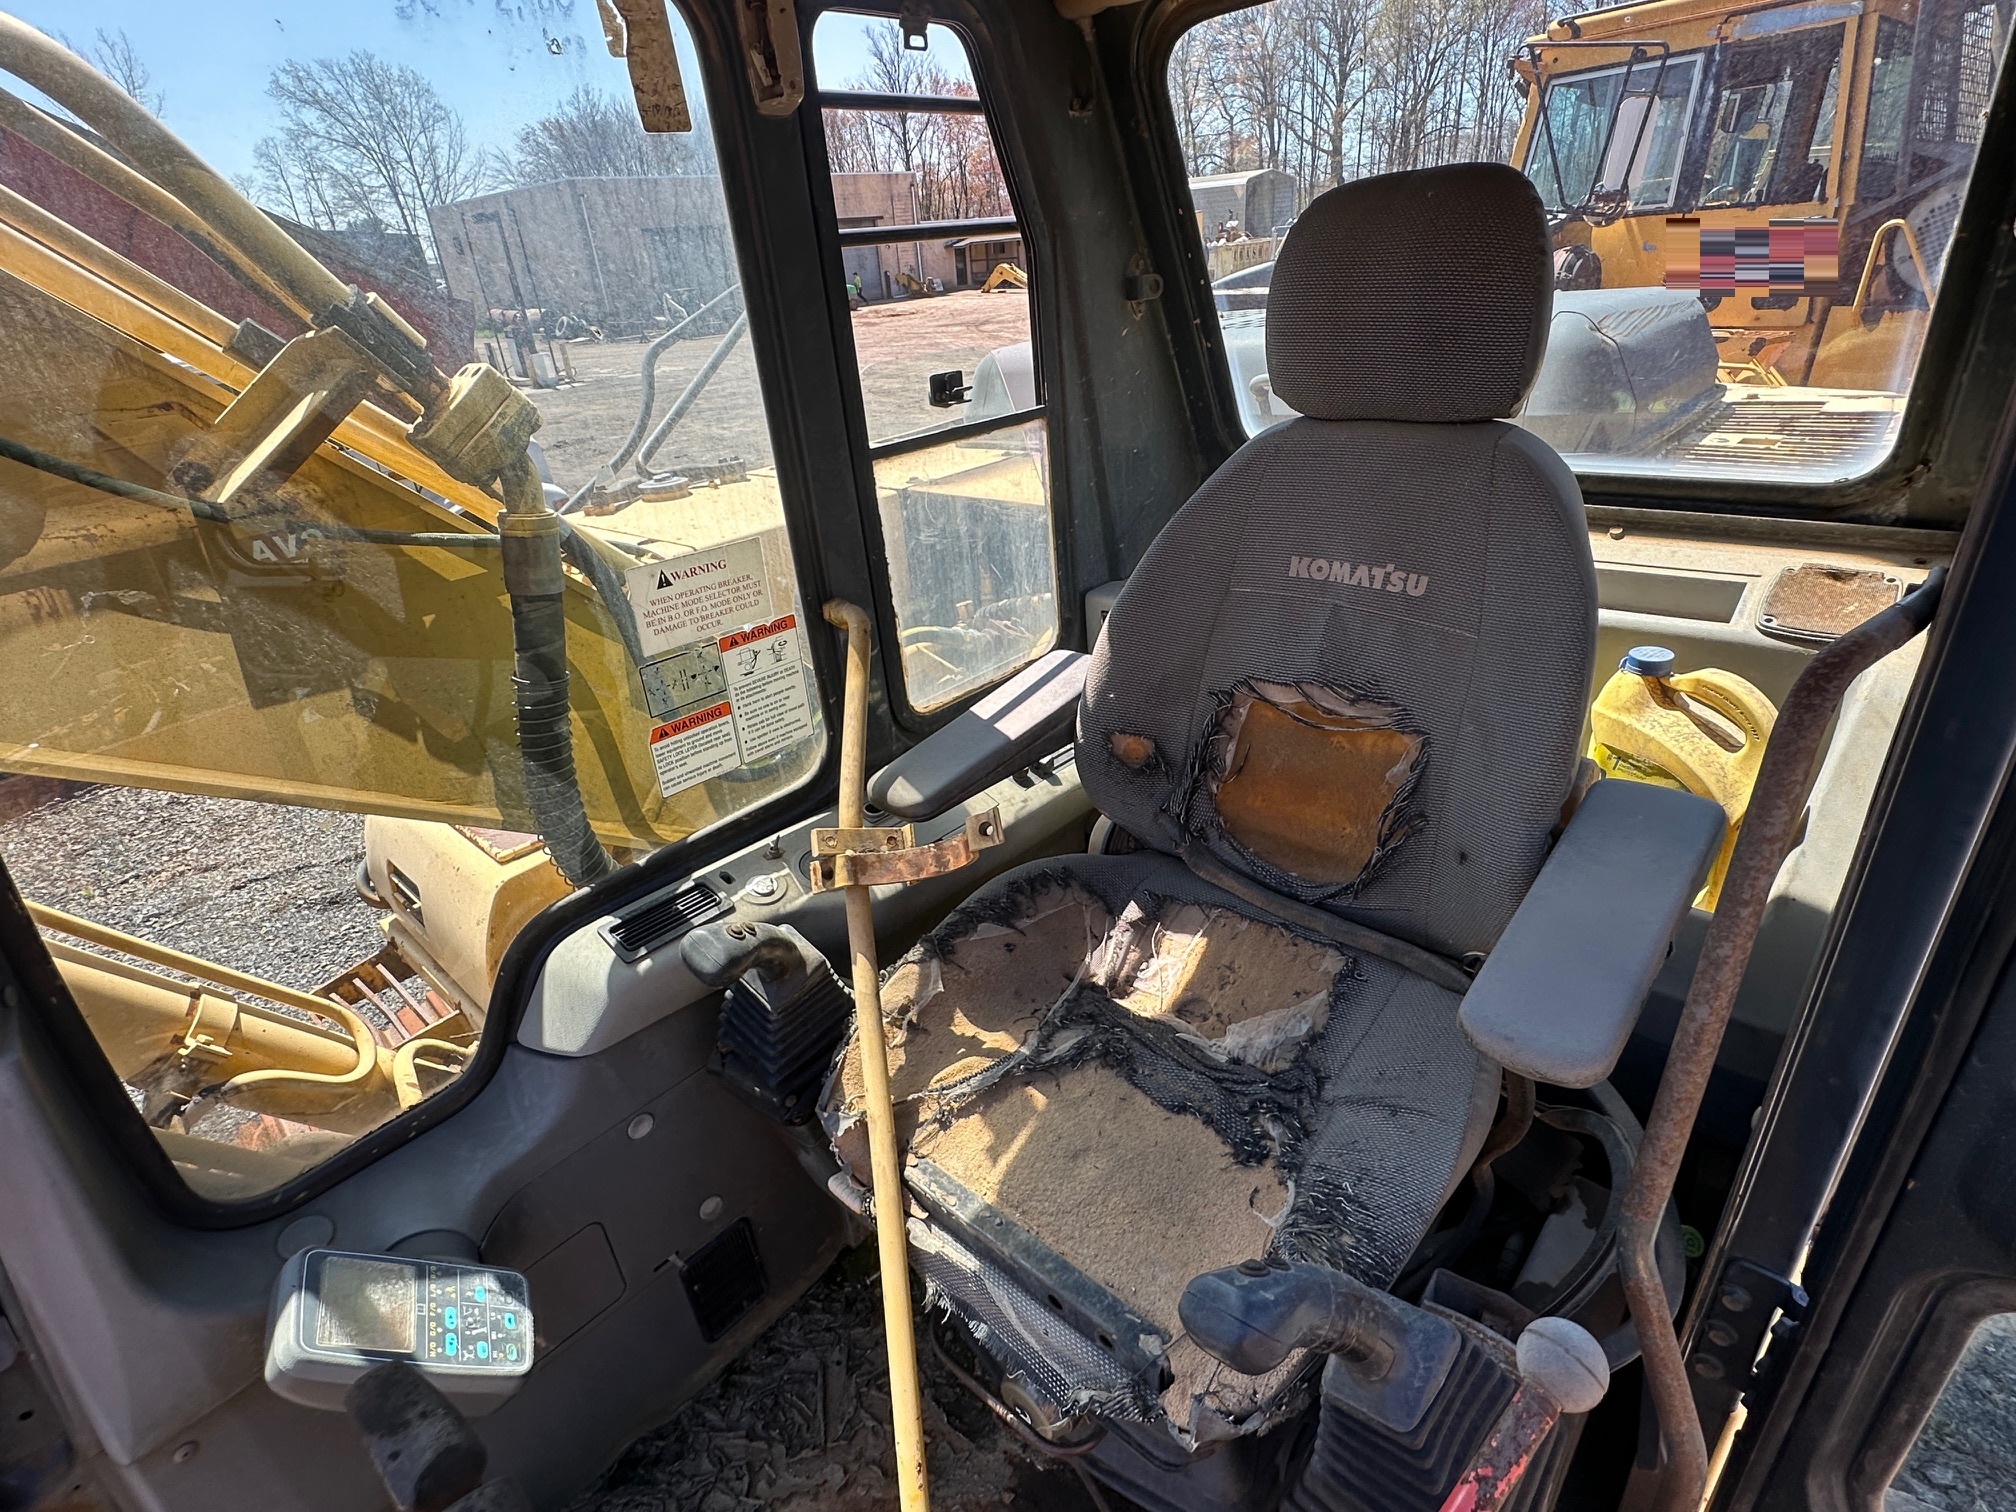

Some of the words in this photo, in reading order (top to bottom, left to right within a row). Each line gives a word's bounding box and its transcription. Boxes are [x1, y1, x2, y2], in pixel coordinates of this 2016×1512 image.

[670, 559, 726, 581] WARNING
[1289, 556, 1428, 597] KOMATSU
[642, 602, 680, 619] MACHINE
[680, 596, 704, 608] MODE
[704, 586, 742, 602] SELECTOR
[742, 580, 761, 591] MUST
[650, 594, 674, 606] WHEN
[674, 583, 717, 600] OPERATING
[718, 573, 753, 588] BREAKER,
[646, 619, 657, 628] BE
[658, 616, 666, 625] IN
[683, 608, 695, 617] OR
[710, 598, 732, 610] MODE
[732, 592, 751, 603] ONLY
[752, 589, 764, 597] OR
[653, 620, 688, 636] DAMAGE
[688, 617, 700, 625] TO
[700, 606, 735, 622] BREAKER
[735, 599, 760, 612] COULD
[741, 620, 787, 642] WARNING
[671, 708, 722, 733] WARNING
